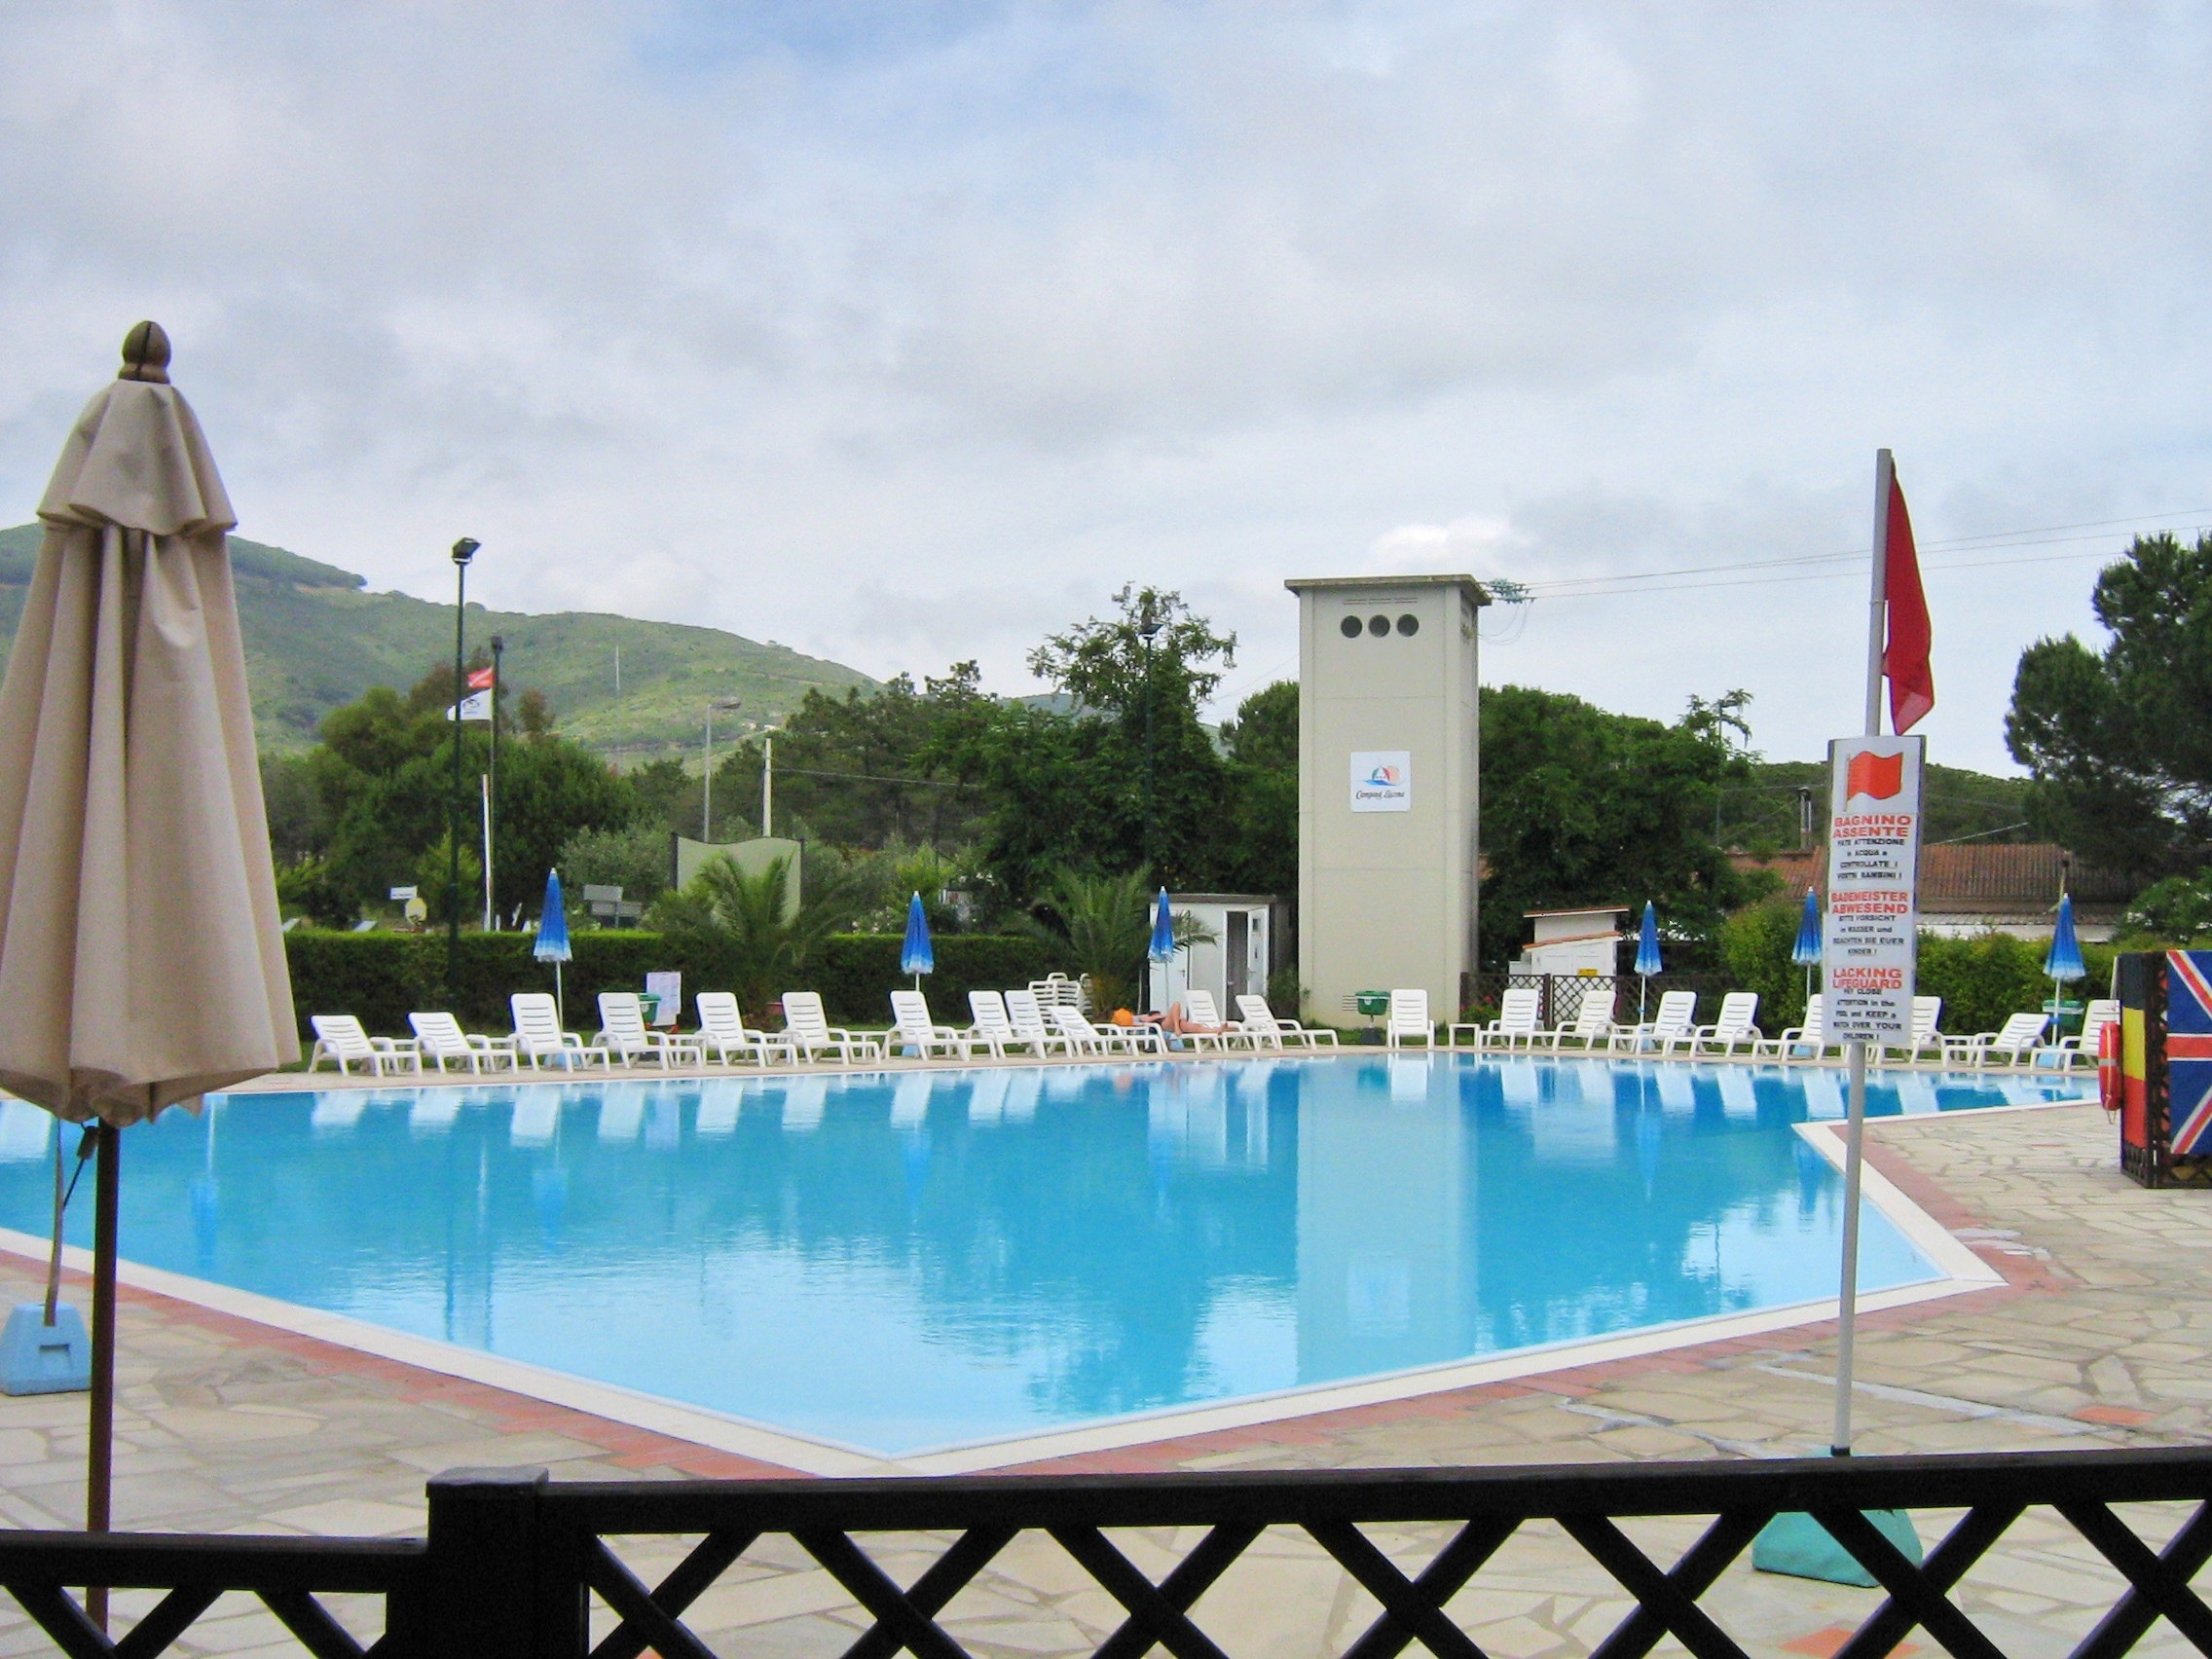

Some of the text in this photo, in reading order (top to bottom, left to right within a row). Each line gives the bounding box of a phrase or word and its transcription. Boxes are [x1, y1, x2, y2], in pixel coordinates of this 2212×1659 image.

[1834, 815, 1911, 827] BAGNINO
[1833, 827, 1908, 838] ASSENTE
[1831, 891, 1908, 903] BADEMEISTER
[1832, 903, 1908, 914] ABWESEND
[1833, 968, 1901, 978] LACKING
[1832, 978, 1901, 989] LIFEGUARD
